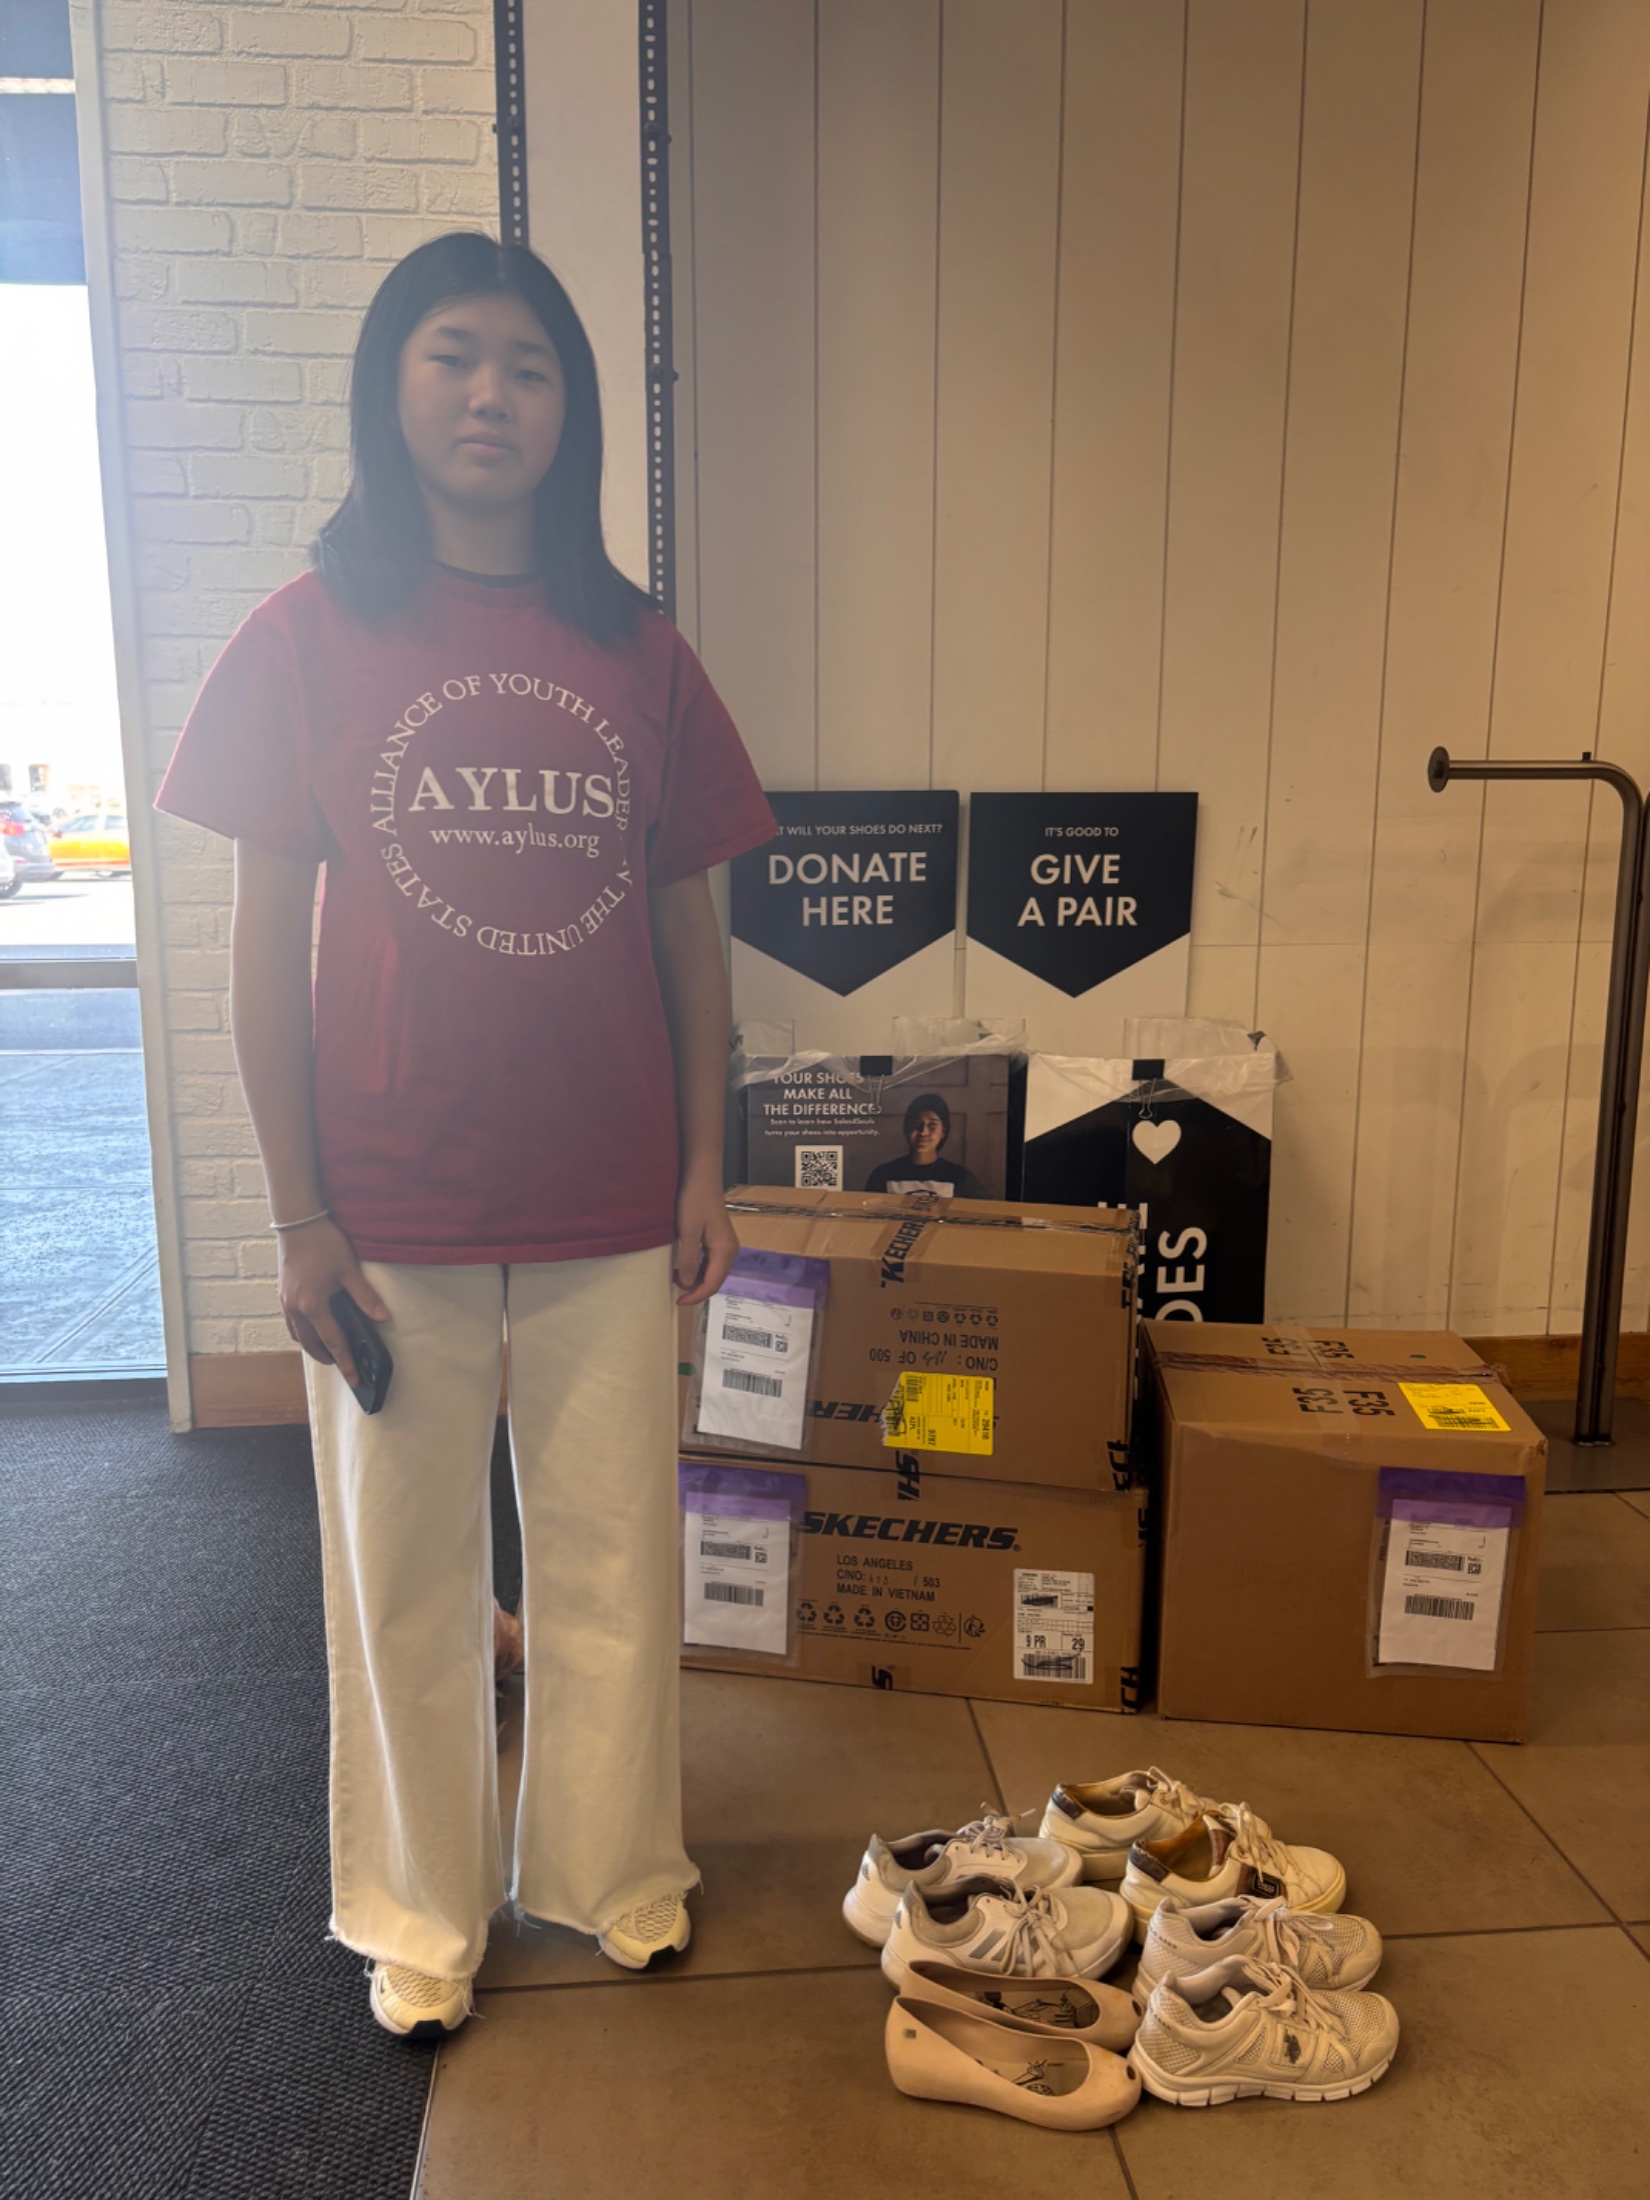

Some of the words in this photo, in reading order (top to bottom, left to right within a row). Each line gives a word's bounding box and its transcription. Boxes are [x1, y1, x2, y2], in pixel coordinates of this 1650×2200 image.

[443, 675, 482, 700] OF
[489, 673, 596, 723] YOUTH
[371, 692, 443, 836] ALLIANCE
[593, 718, 631, 834] LEADER
[408, 766, 615, 818] AYLUS
[430, 823, 600, 858] www.aylus.org
[787, 825, 812, 836] WILL
[815, 825, 847, 835] YOUR
[849, 824, 886, 835] SHOES
[888, 824, 906, 834] DO
[908, 824, 943, 833] NEXT?
[1045, 827, 1063, 837] IT'S
[1065, 827, 1102, 837] GOOD
[1103, 827, 1119, 836] TO
[769, 852, 927, 885] DONATE
[1031, 854, 1121, 885] GIVE
[381, 843, 473, 937] STATES
[580, 886, 626, 935] THE
[802, 895, 894, 927] HERE
[1017, 897, 1045, 927] A
[1057, 896, 1138, 927] PAIR
[477, 924, 584, 956] UNITED
[816, 1072, 864, 1084] SHOS
[783, 1088, 826, 1100] MAKE
[828, 1088, 853, 1100] ALL
[763, 1104, 790, 1115] THE
[793, 1103, 878, 1115] DIFFERENCE
[899, 1330, 940, 1346] CHINA
[943, 1333, 957, 1348] IN
[962, 1334, 999, 1350] MADE
[869, 1348, 892, 1362] 500
[898, 1351, 916, 1364] OF
[800, 1511, 1018, 1551] SKECHERS
[836, 1555, 859, 1567] LOS
[863, 1557, 914, 1571] ANGELES
[836, 1582, 867, 1596] MADE
[872, 1585, 883, 1597] IN
[888, 1586, 936, 1602] VIETNAM
